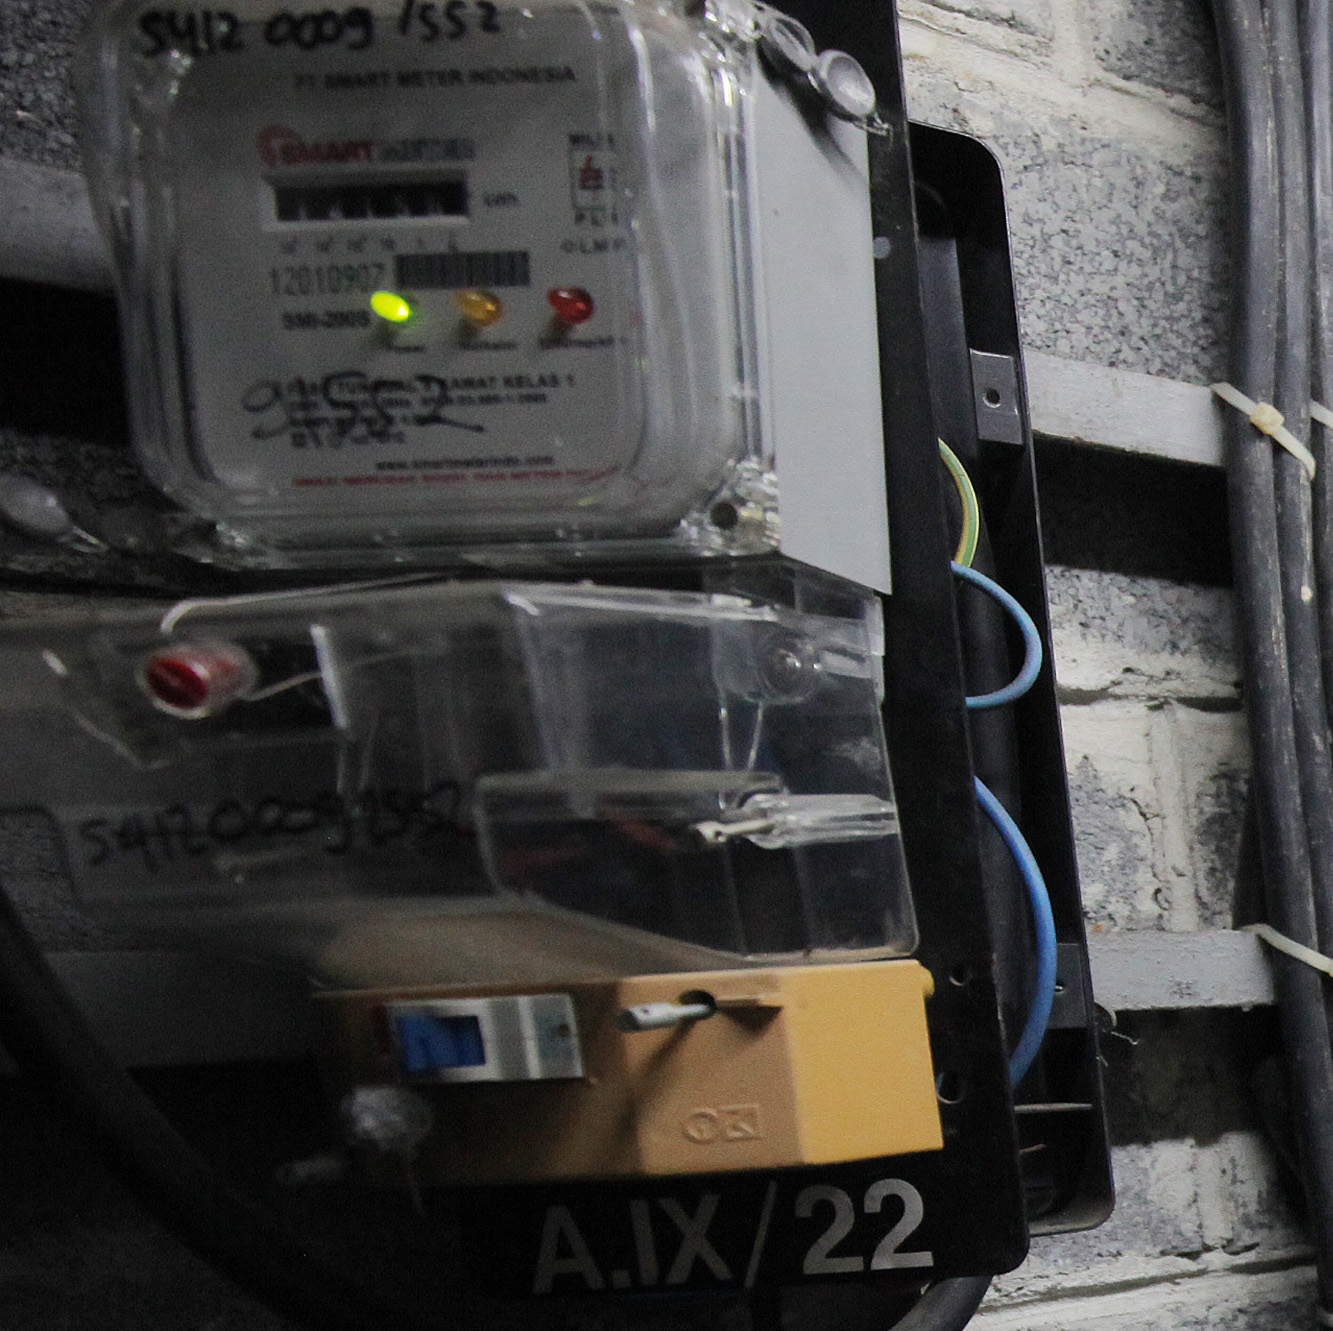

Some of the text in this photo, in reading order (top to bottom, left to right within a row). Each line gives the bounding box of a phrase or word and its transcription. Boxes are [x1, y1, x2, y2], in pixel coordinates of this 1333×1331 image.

[323, 69, 390, 91] SMART
[397, 67, 462, 89] METER
[469, 64, 577, 87] INDONESIA
[532, 1178, 935, 1294] A.IX/22
